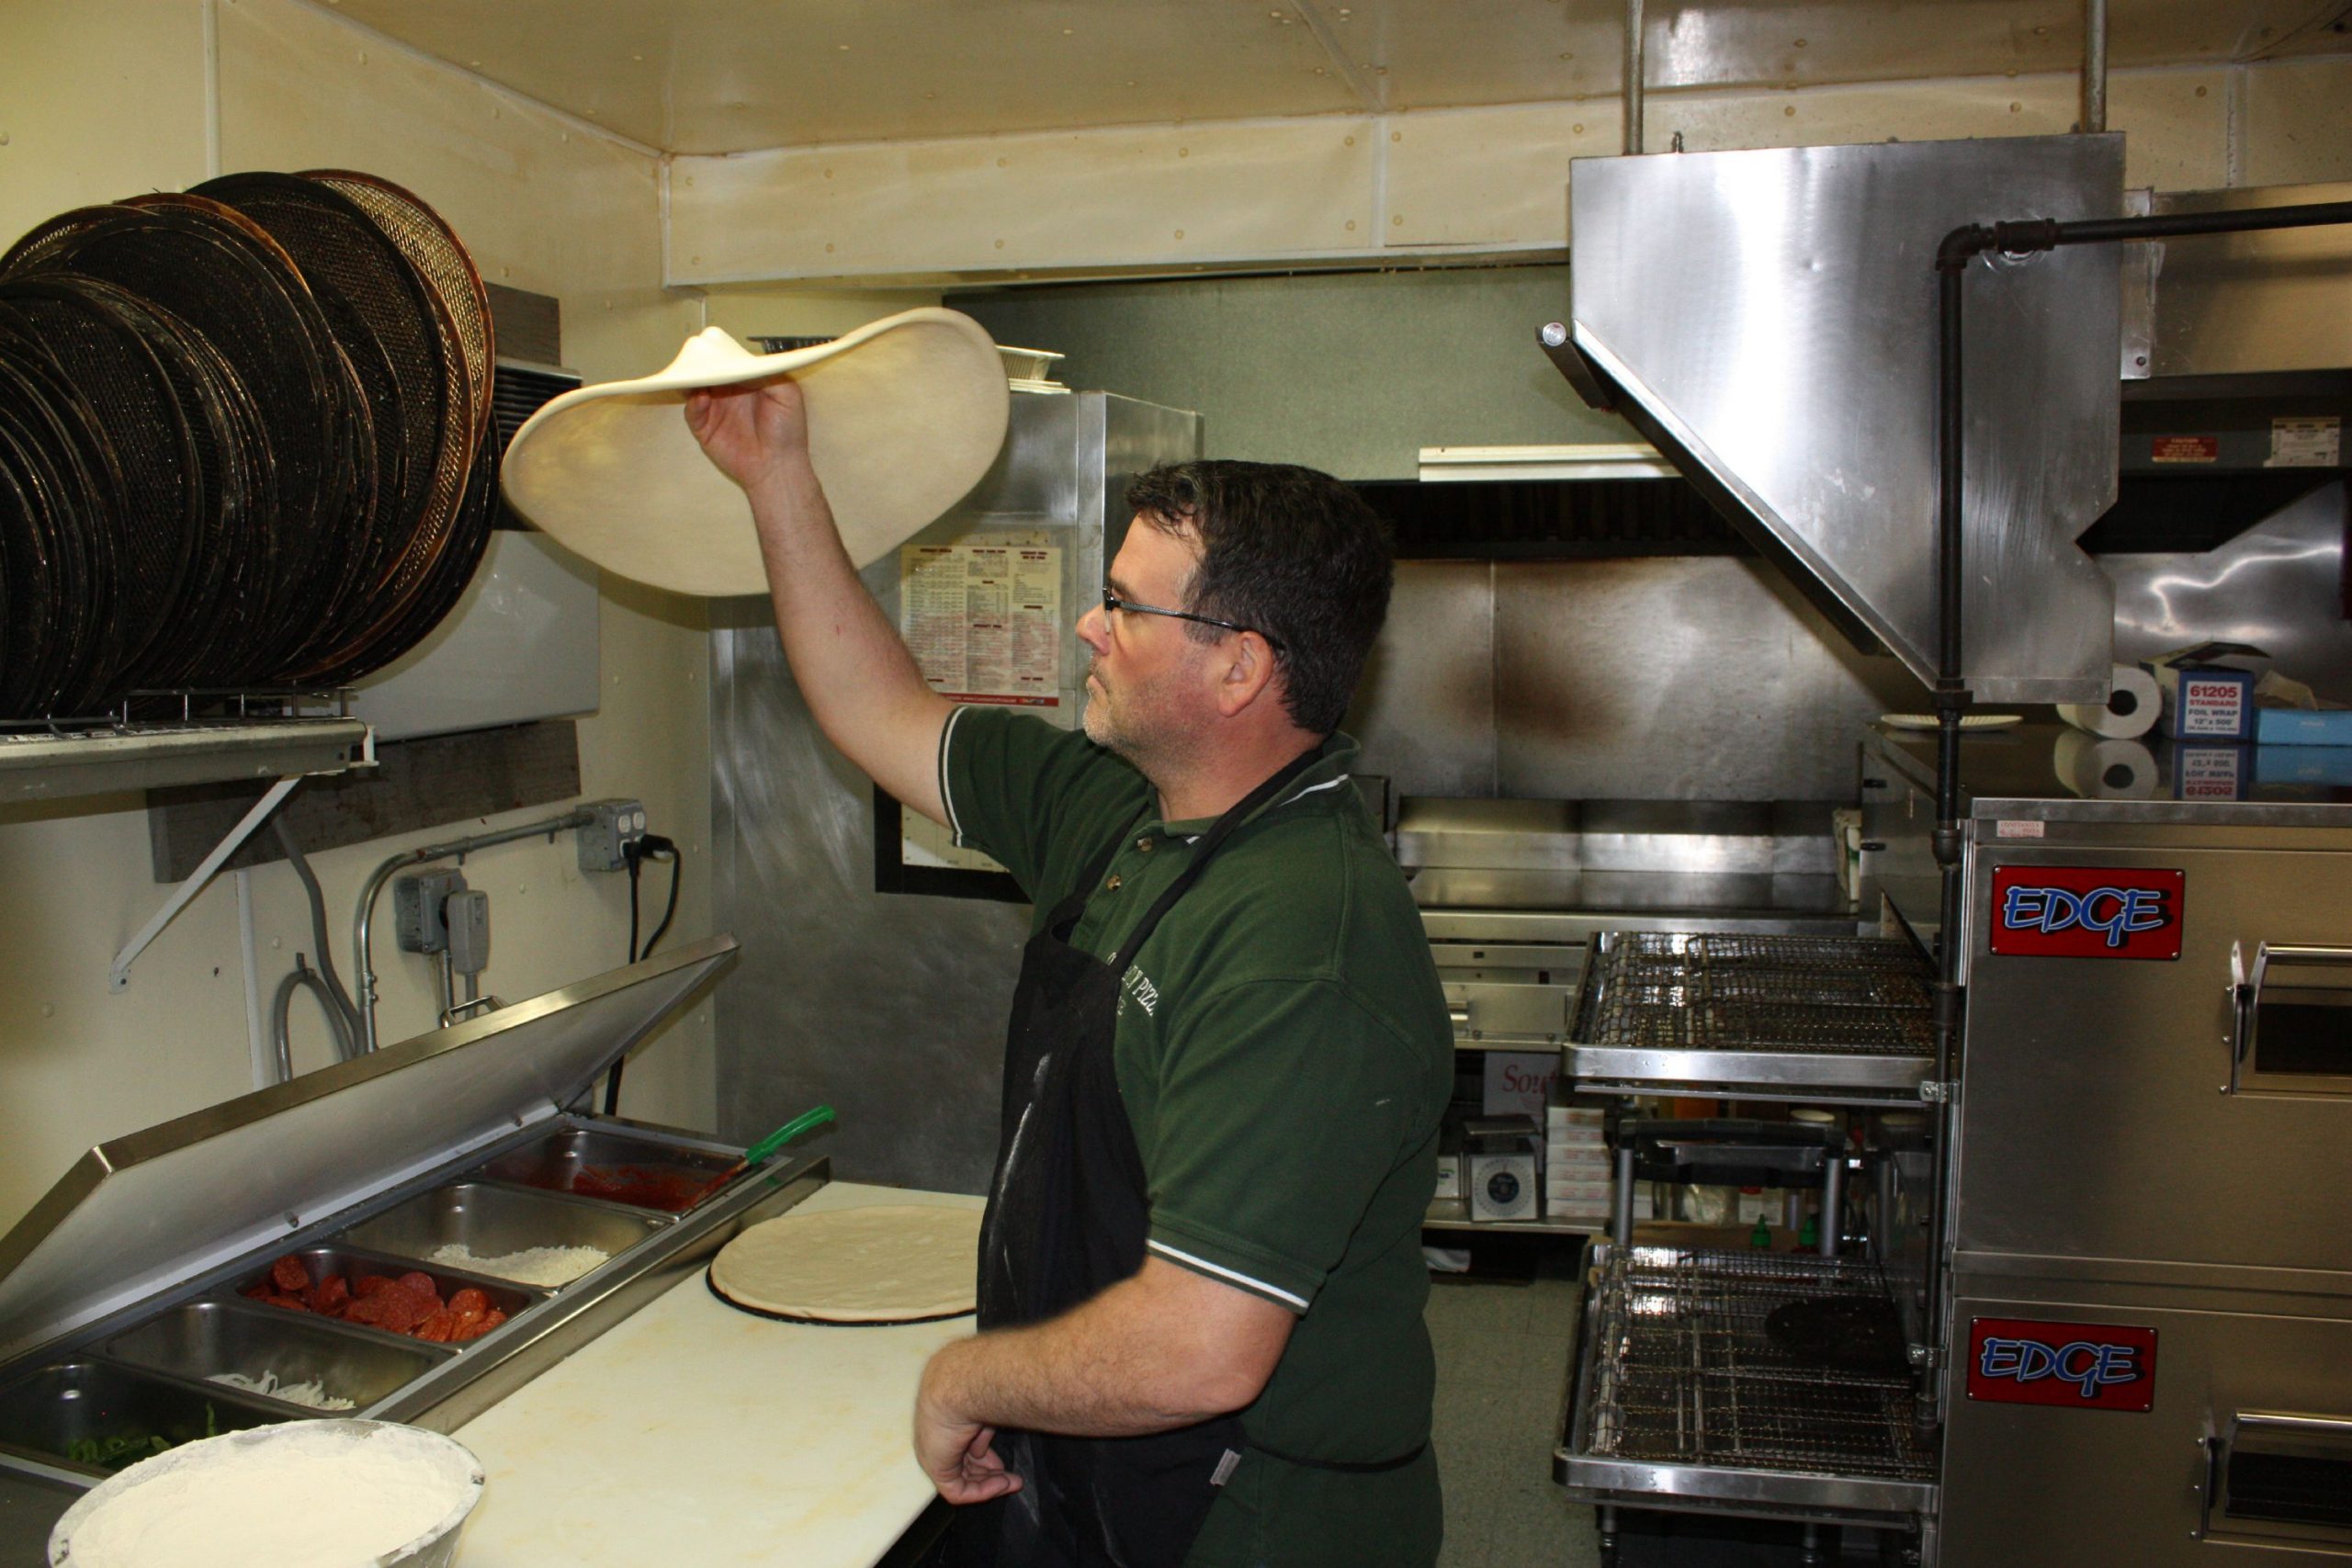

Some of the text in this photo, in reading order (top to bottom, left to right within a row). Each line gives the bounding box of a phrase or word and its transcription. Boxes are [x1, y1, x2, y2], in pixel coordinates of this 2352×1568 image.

[2189, 685, 2237, 698] 61205
[2189, 699, 2238, 707] STANDARD
[2004, 886, 2167, 947] EDGE
[1132, 976, 1159, 1017] PIZZ
[1981, 1337, 2140, 1398] EDGE
